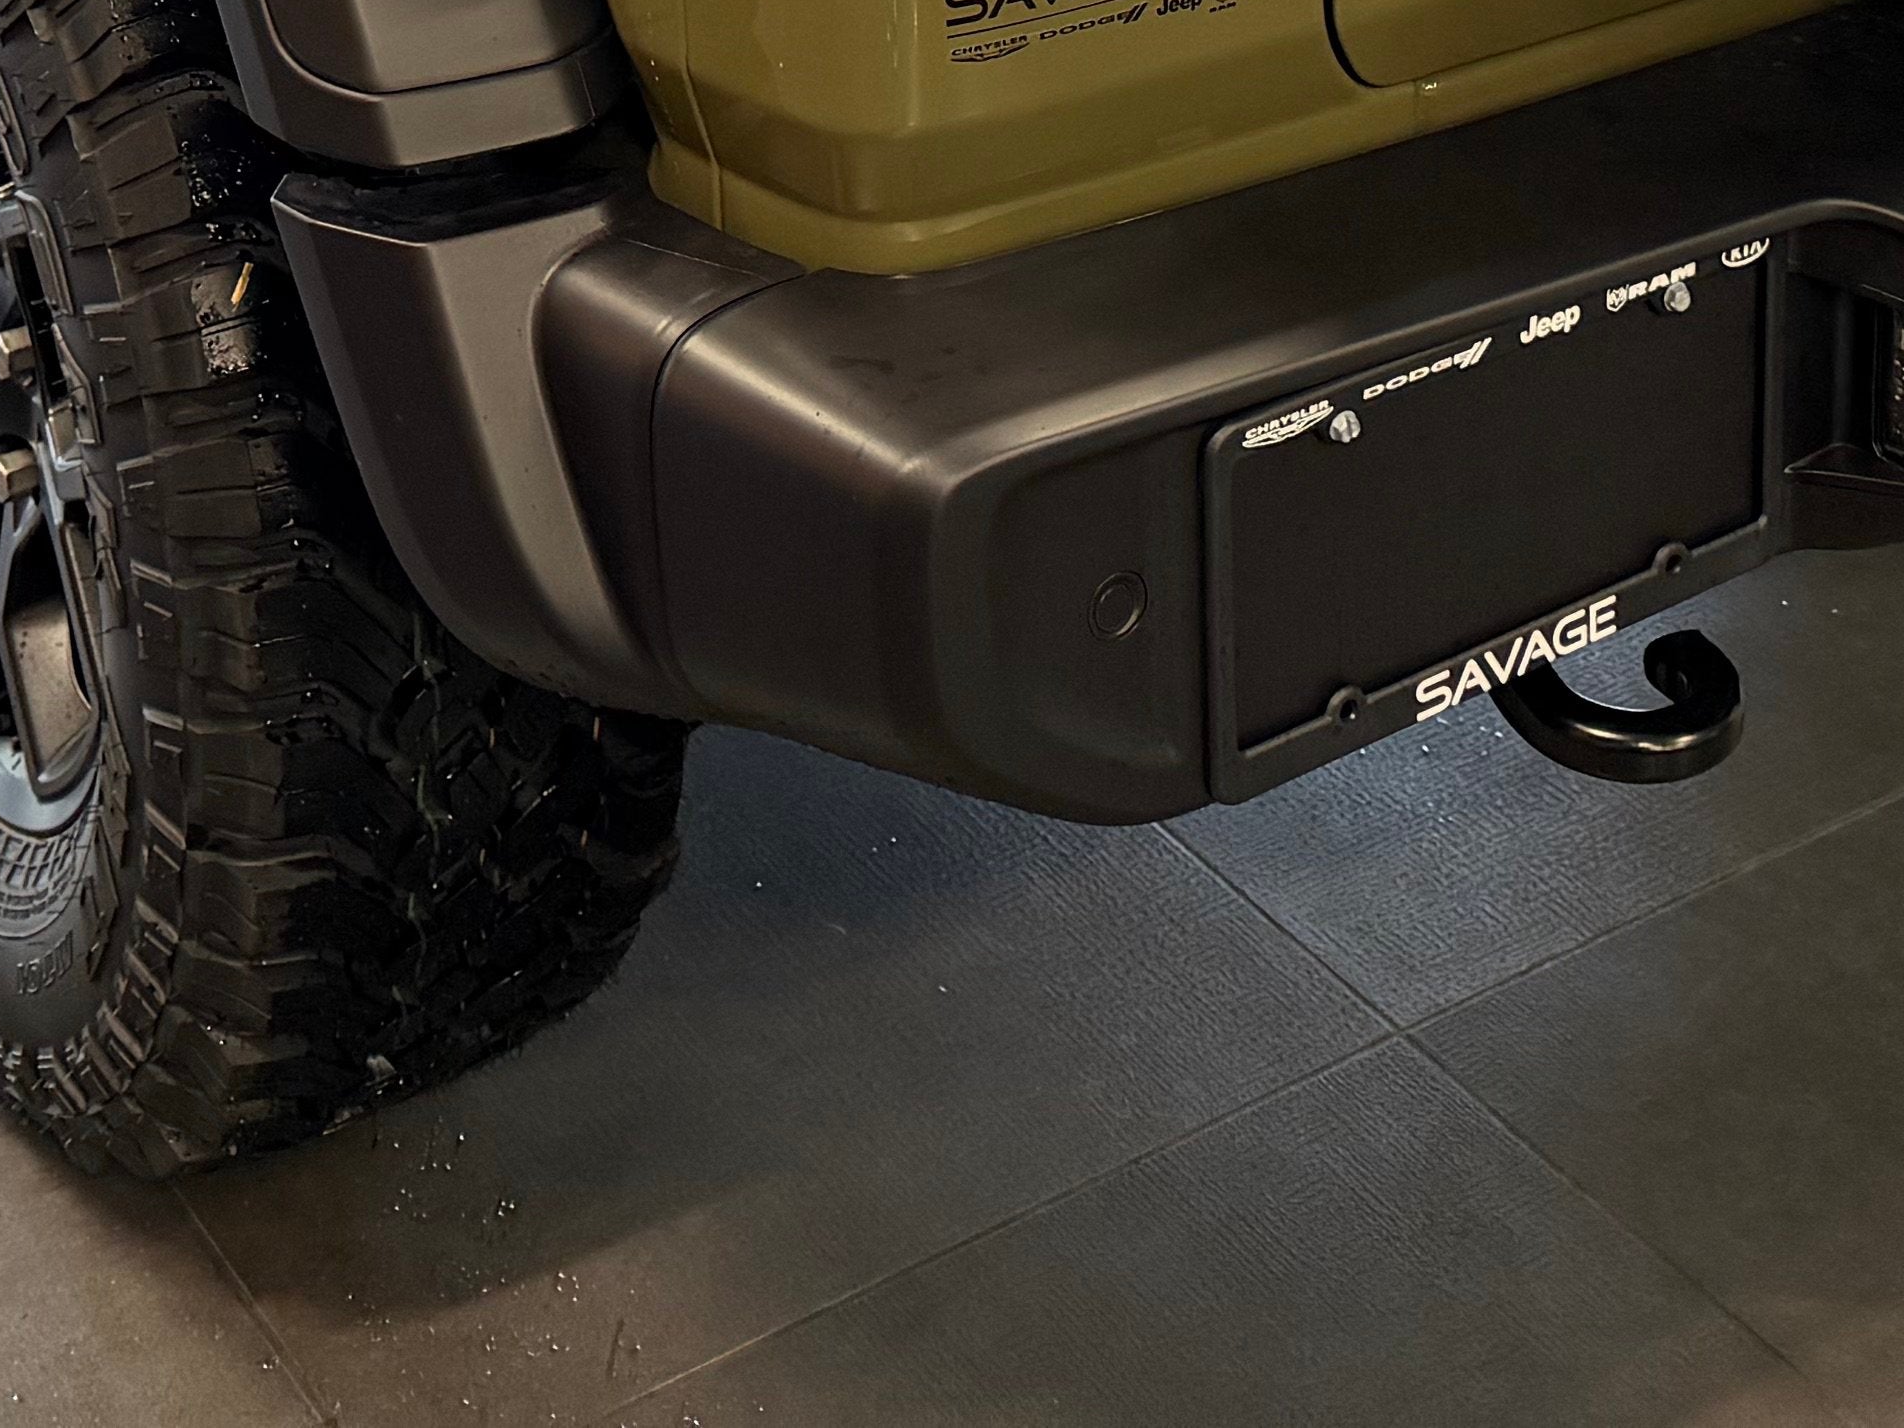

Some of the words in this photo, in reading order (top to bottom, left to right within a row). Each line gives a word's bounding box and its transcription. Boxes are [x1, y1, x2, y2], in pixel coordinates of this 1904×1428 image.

[1244, 400, 1330, 439] CHRYSLER
[1363, 348, 1474, 400] DODGE
[1520, 305, 1582, 343] Jeep
[1628, 262, 1696, 301] RAM
[1415, 595, 1617, 722] SAVAGE
